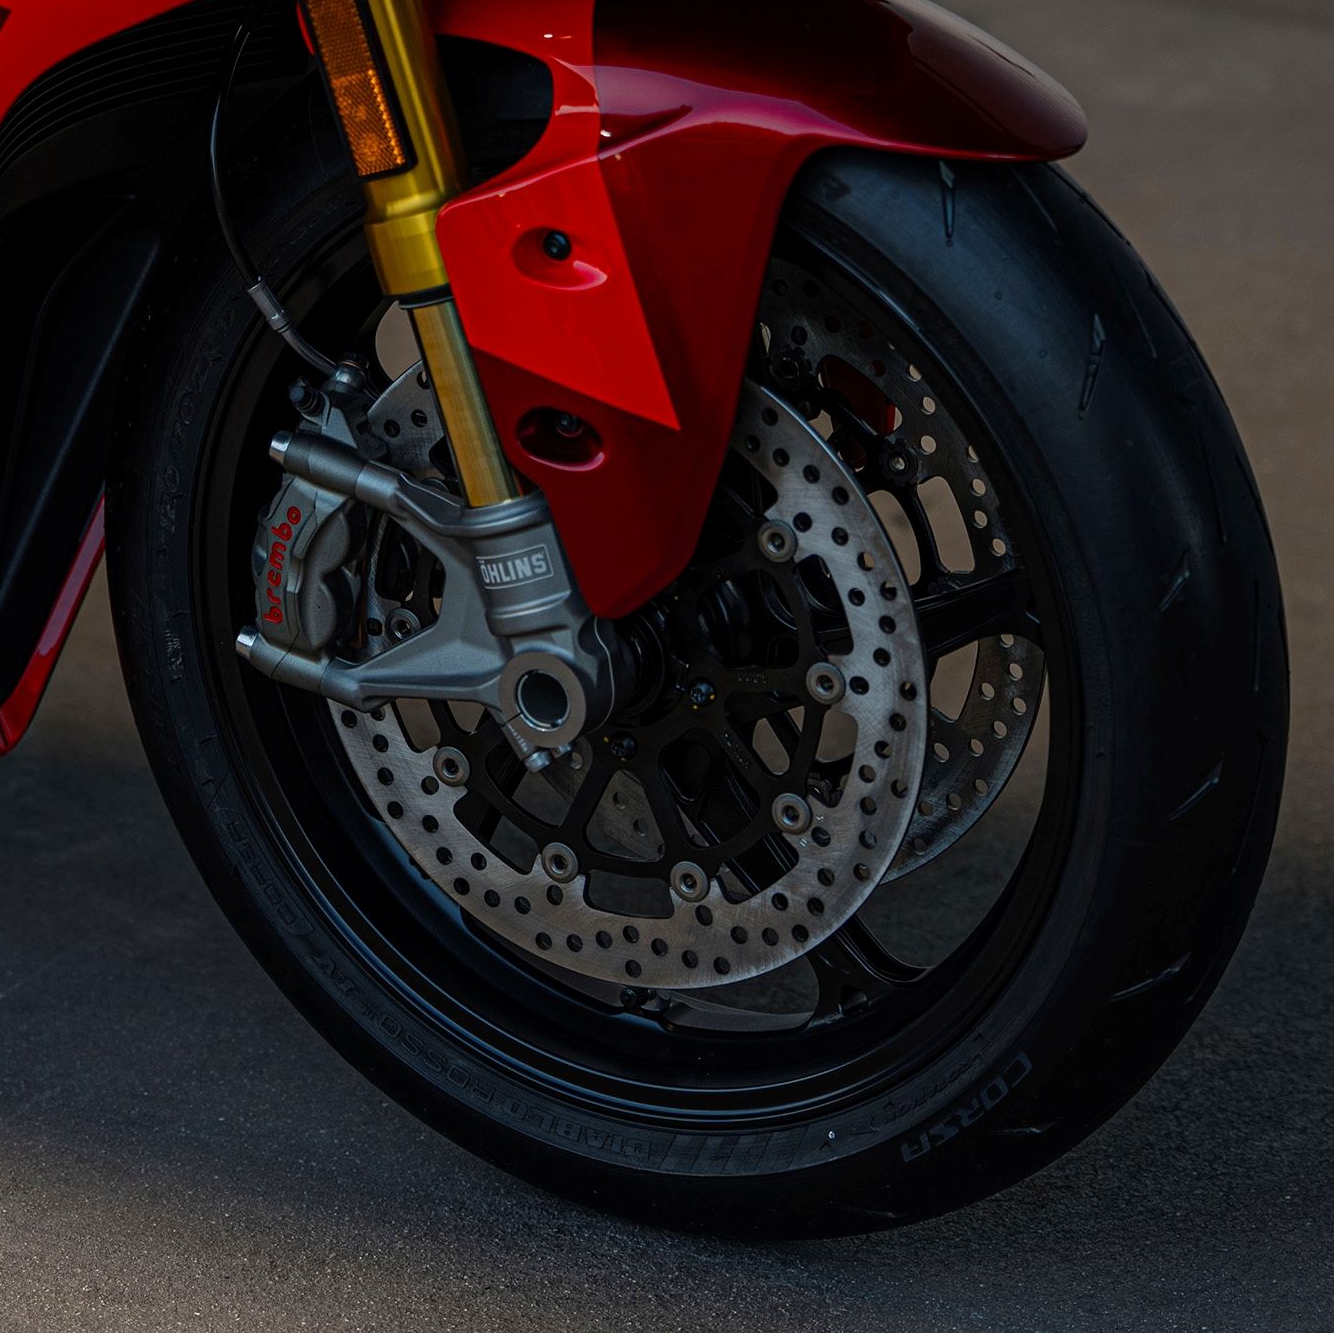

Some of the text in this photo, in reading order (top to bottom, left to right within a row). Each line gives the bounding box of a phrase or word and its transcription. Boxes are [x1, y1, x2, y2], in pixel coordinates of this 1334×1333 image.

[263, 506, 301, 624] brembo
[479, 553, 547, 585] ÖHLINS
[500, 1098, 651, 1162] DIABLO
[901, 1050, 1034, 1163] CORSA
